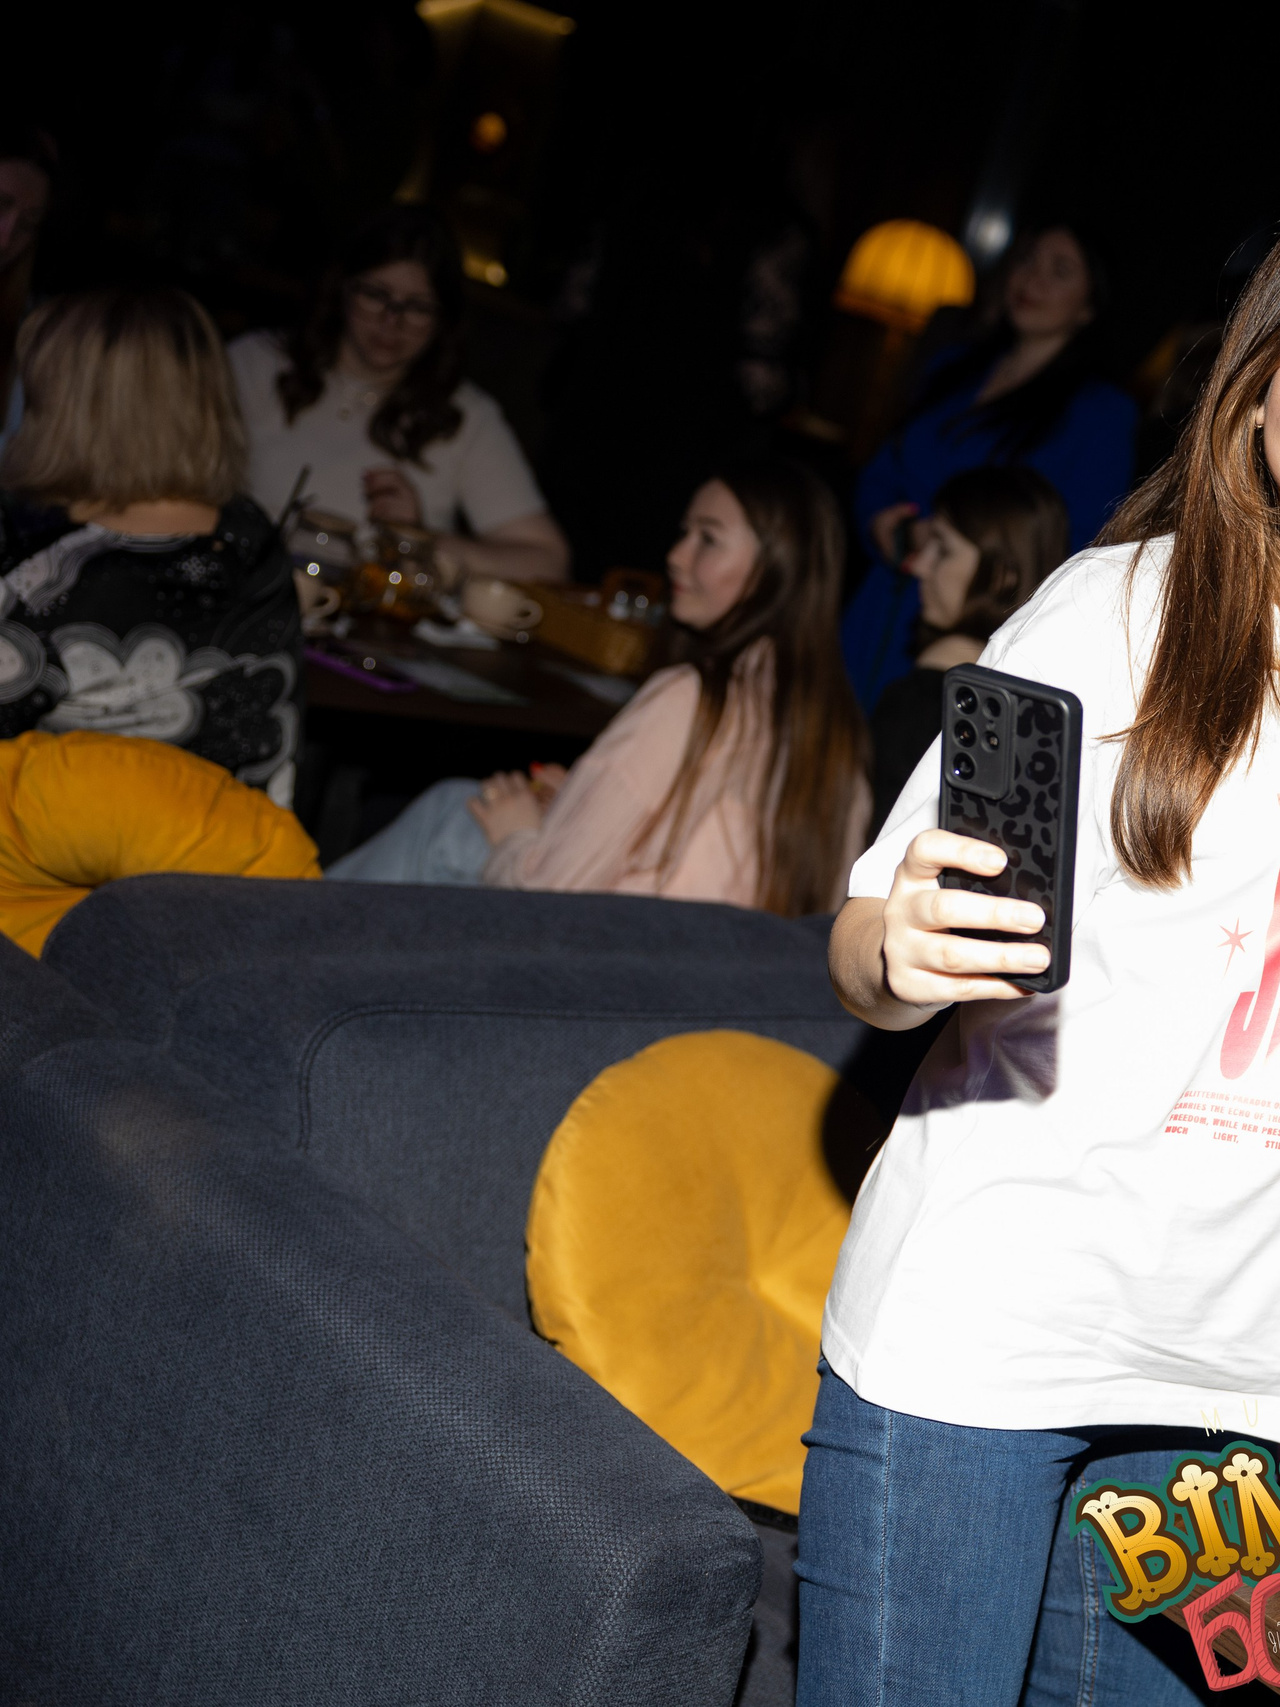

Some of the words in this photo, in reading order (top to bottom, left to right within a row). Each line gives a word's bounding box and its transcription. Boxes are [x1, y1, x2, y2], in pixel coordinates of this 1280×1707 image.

[1232, 1095, 1271, 1108] PARADOX
[1173, 1102, 1207, 1111] CARRIES
[1210, 1104, 1224, 1114] THE
[1227, 1107, 1250, 1118] ECHO
[1254, 1112, 1265, 1120] OF
[1168, 1113, 1209, 1126] FREEDOM,
[1212, 1118, 1238, 1129] WHILE
[1241, 1122, 1259, 1133] HER
[1164, 1125, 1189, 1135] MUCH
[1212, 1131, 1239, 1144] LIGHT,
